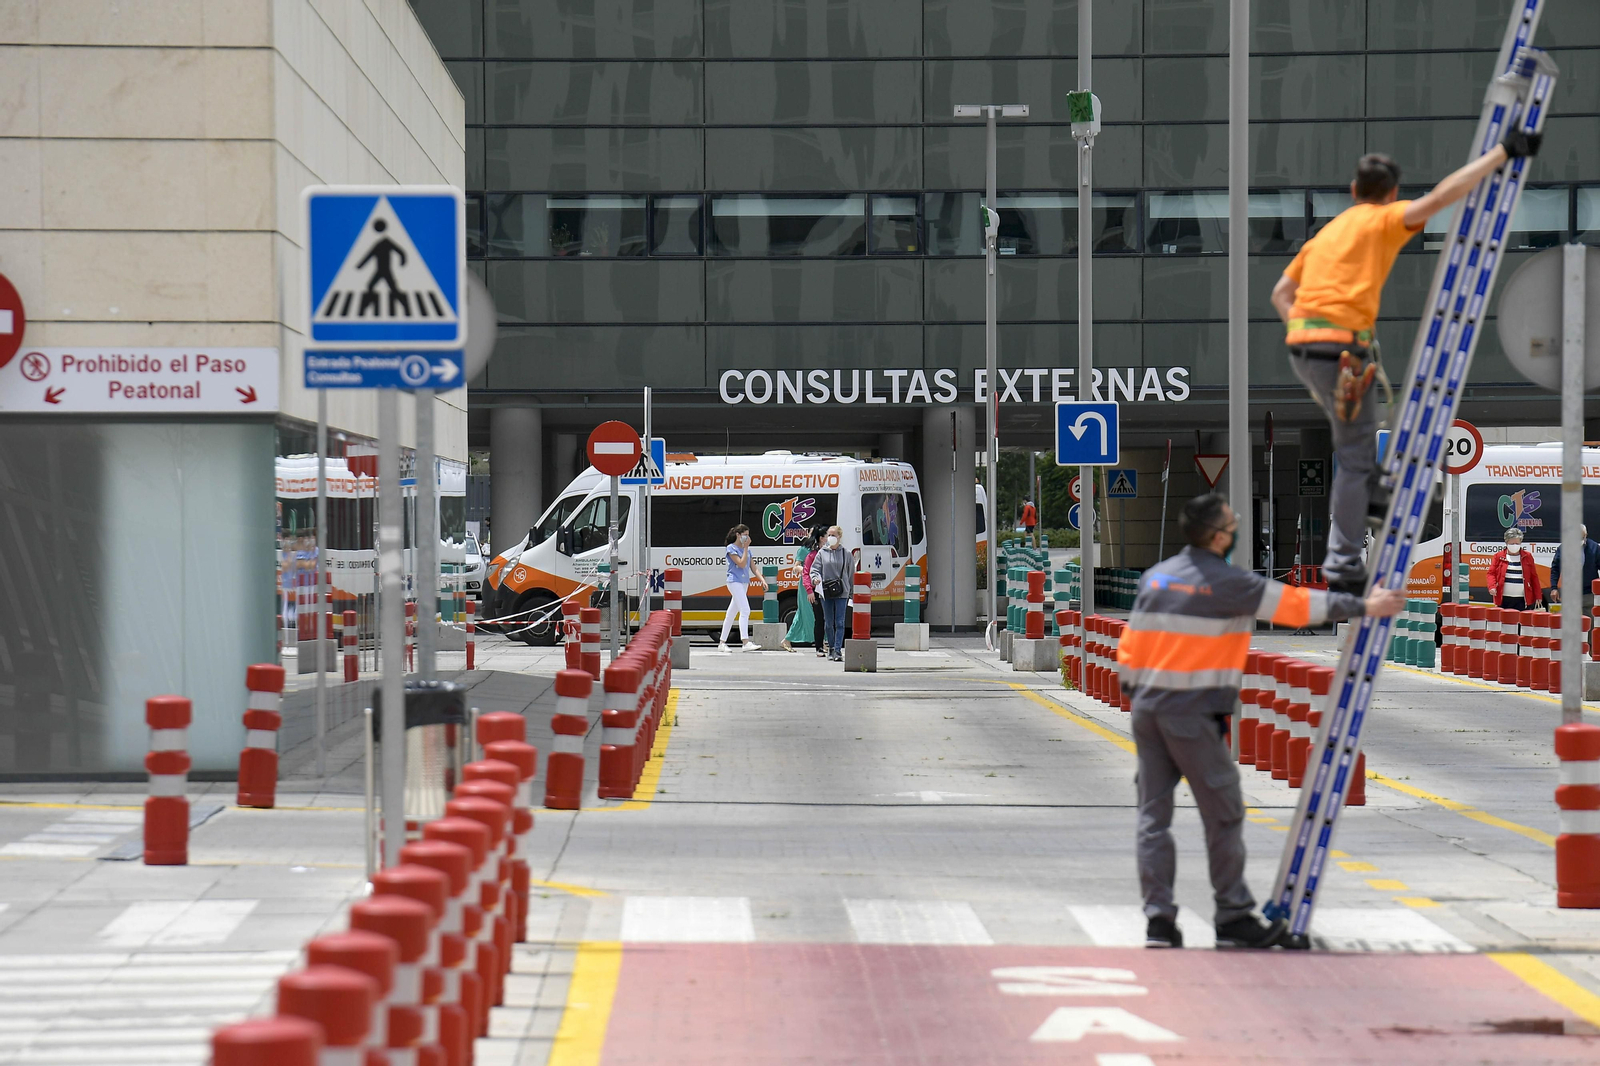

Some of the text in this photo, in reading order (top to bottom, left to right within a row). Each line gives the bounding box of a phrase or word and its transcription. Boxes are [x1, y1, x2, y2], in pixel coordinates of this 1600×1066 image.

[61, 354, 246, 373] Prohibido el Paso
[108, 380, 201, 399] Peatonal
[719, 366, 1191, 404] CONSULTAS EXTERNAS
[1446, 438, 1472, 456] 20
[1485, 465, 1563, 478] TRANSPORTE
[750, 474, 839, 489] COLECTIVO
[665, 555, 713, 566] CONSORCIO
[716, 557, 726, 566] DE
